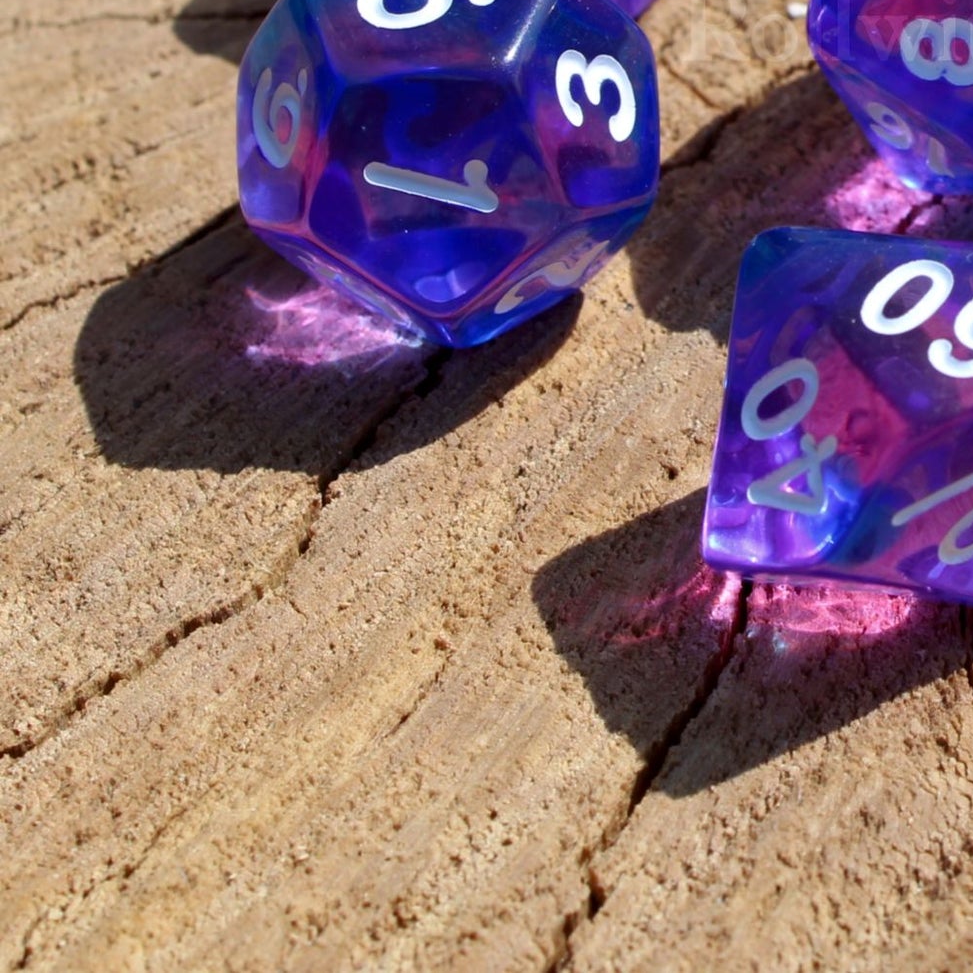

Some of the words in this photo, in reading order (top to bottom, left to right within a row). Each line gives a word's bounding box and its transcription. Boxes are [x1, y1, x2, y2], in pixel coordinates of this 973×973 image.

[555, 49, 636, 142] 3
[363, 159, 499, 213] 1
[741, 357, 839, 516] 40
